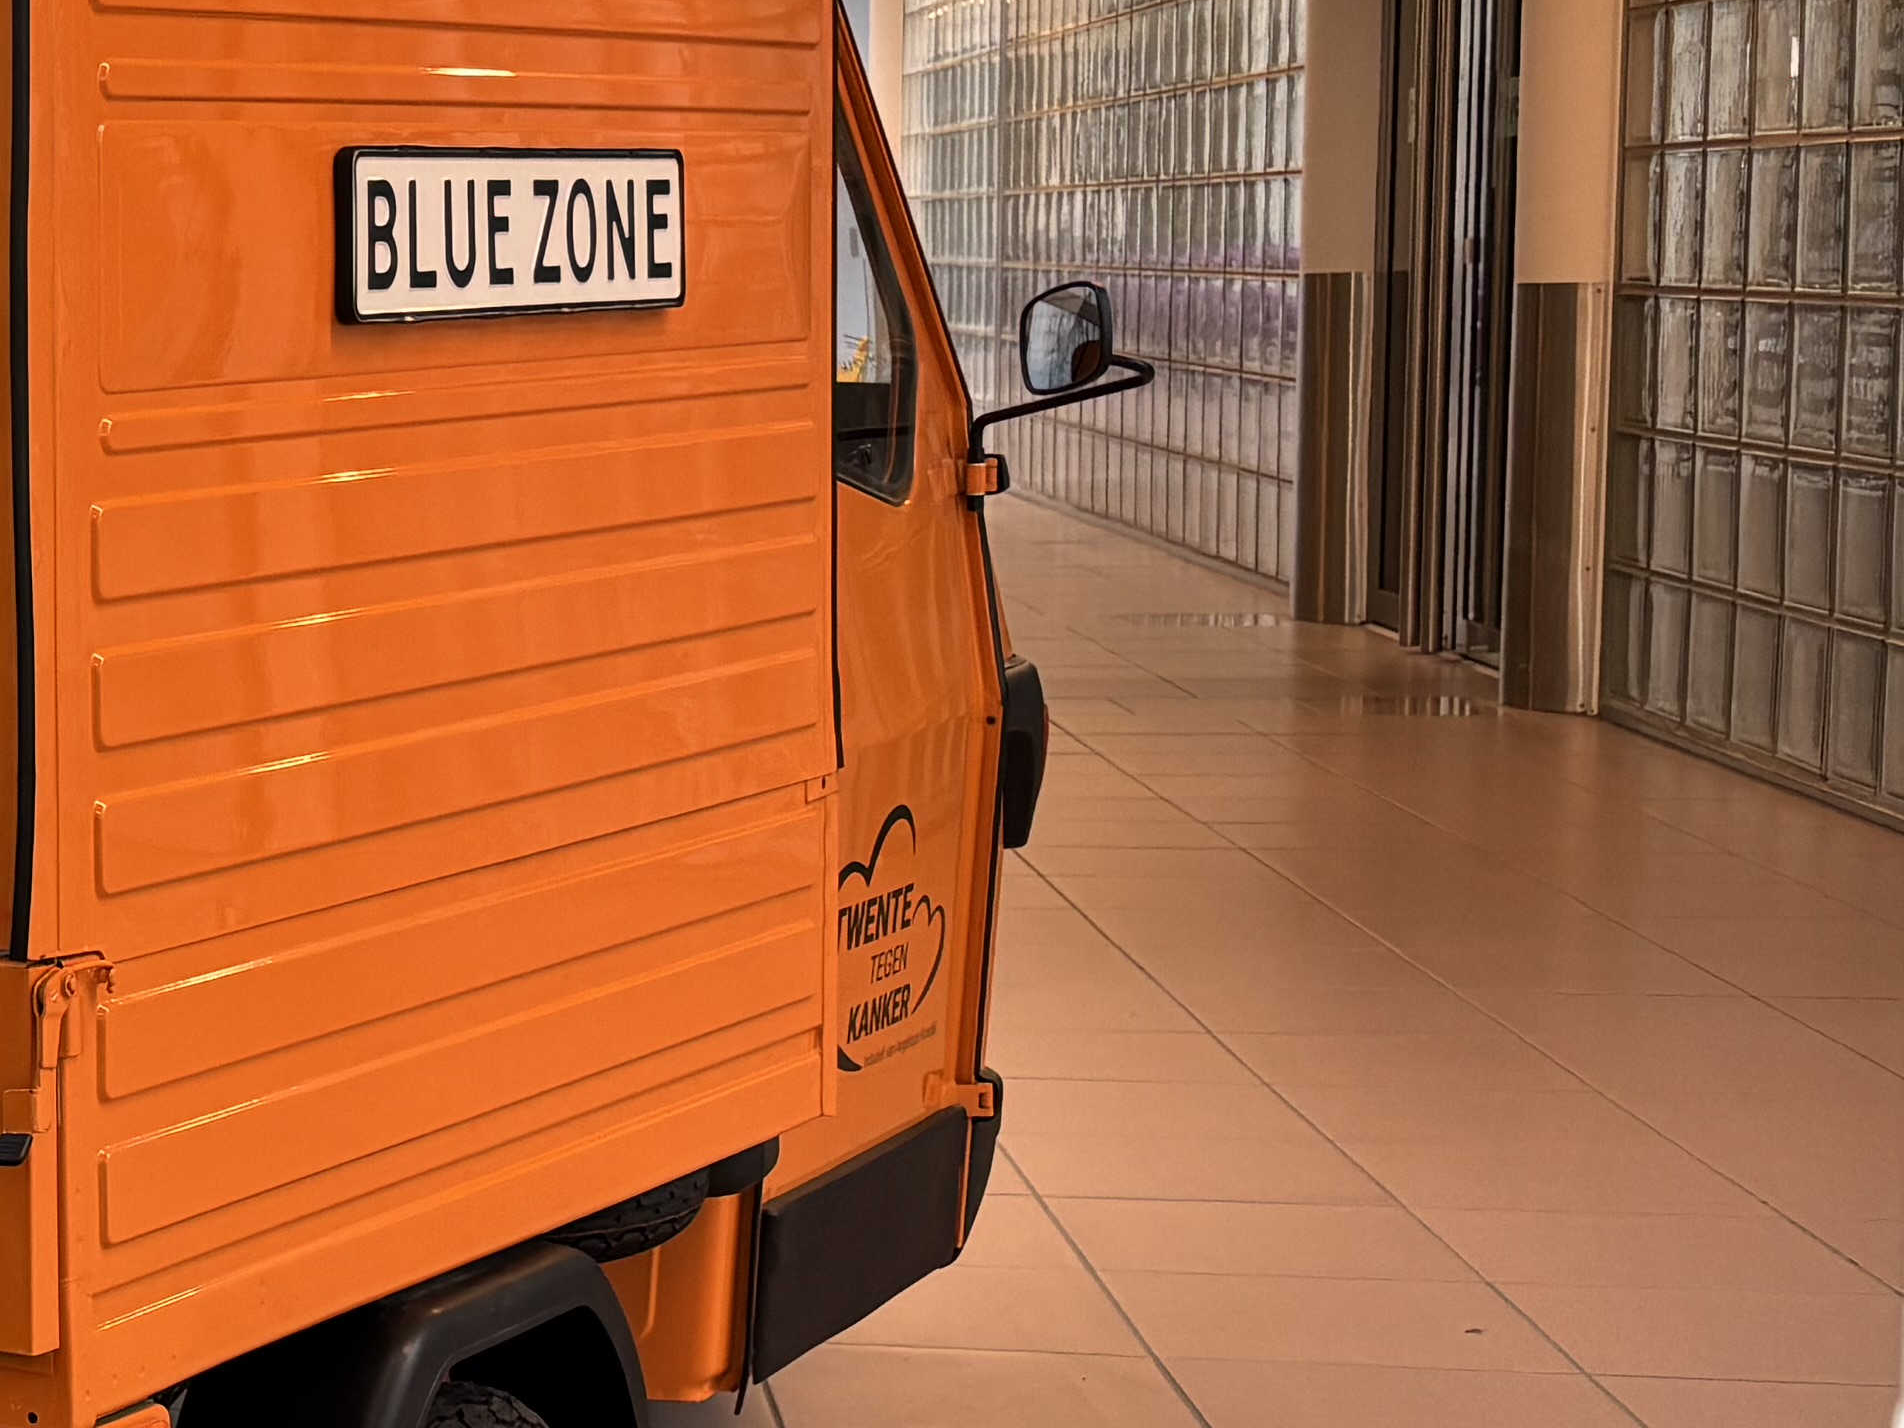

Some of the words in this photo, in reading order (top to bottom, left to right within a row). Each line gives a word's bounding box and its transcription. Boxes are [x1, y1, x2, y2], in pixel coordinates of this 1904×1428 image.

[367, 179, 515, 290] BLUE
[533, 177, 673, 284] ZONE
[871, 941, 909, 984] TEGEN
[847, 983, 911, 1044] KANKER
